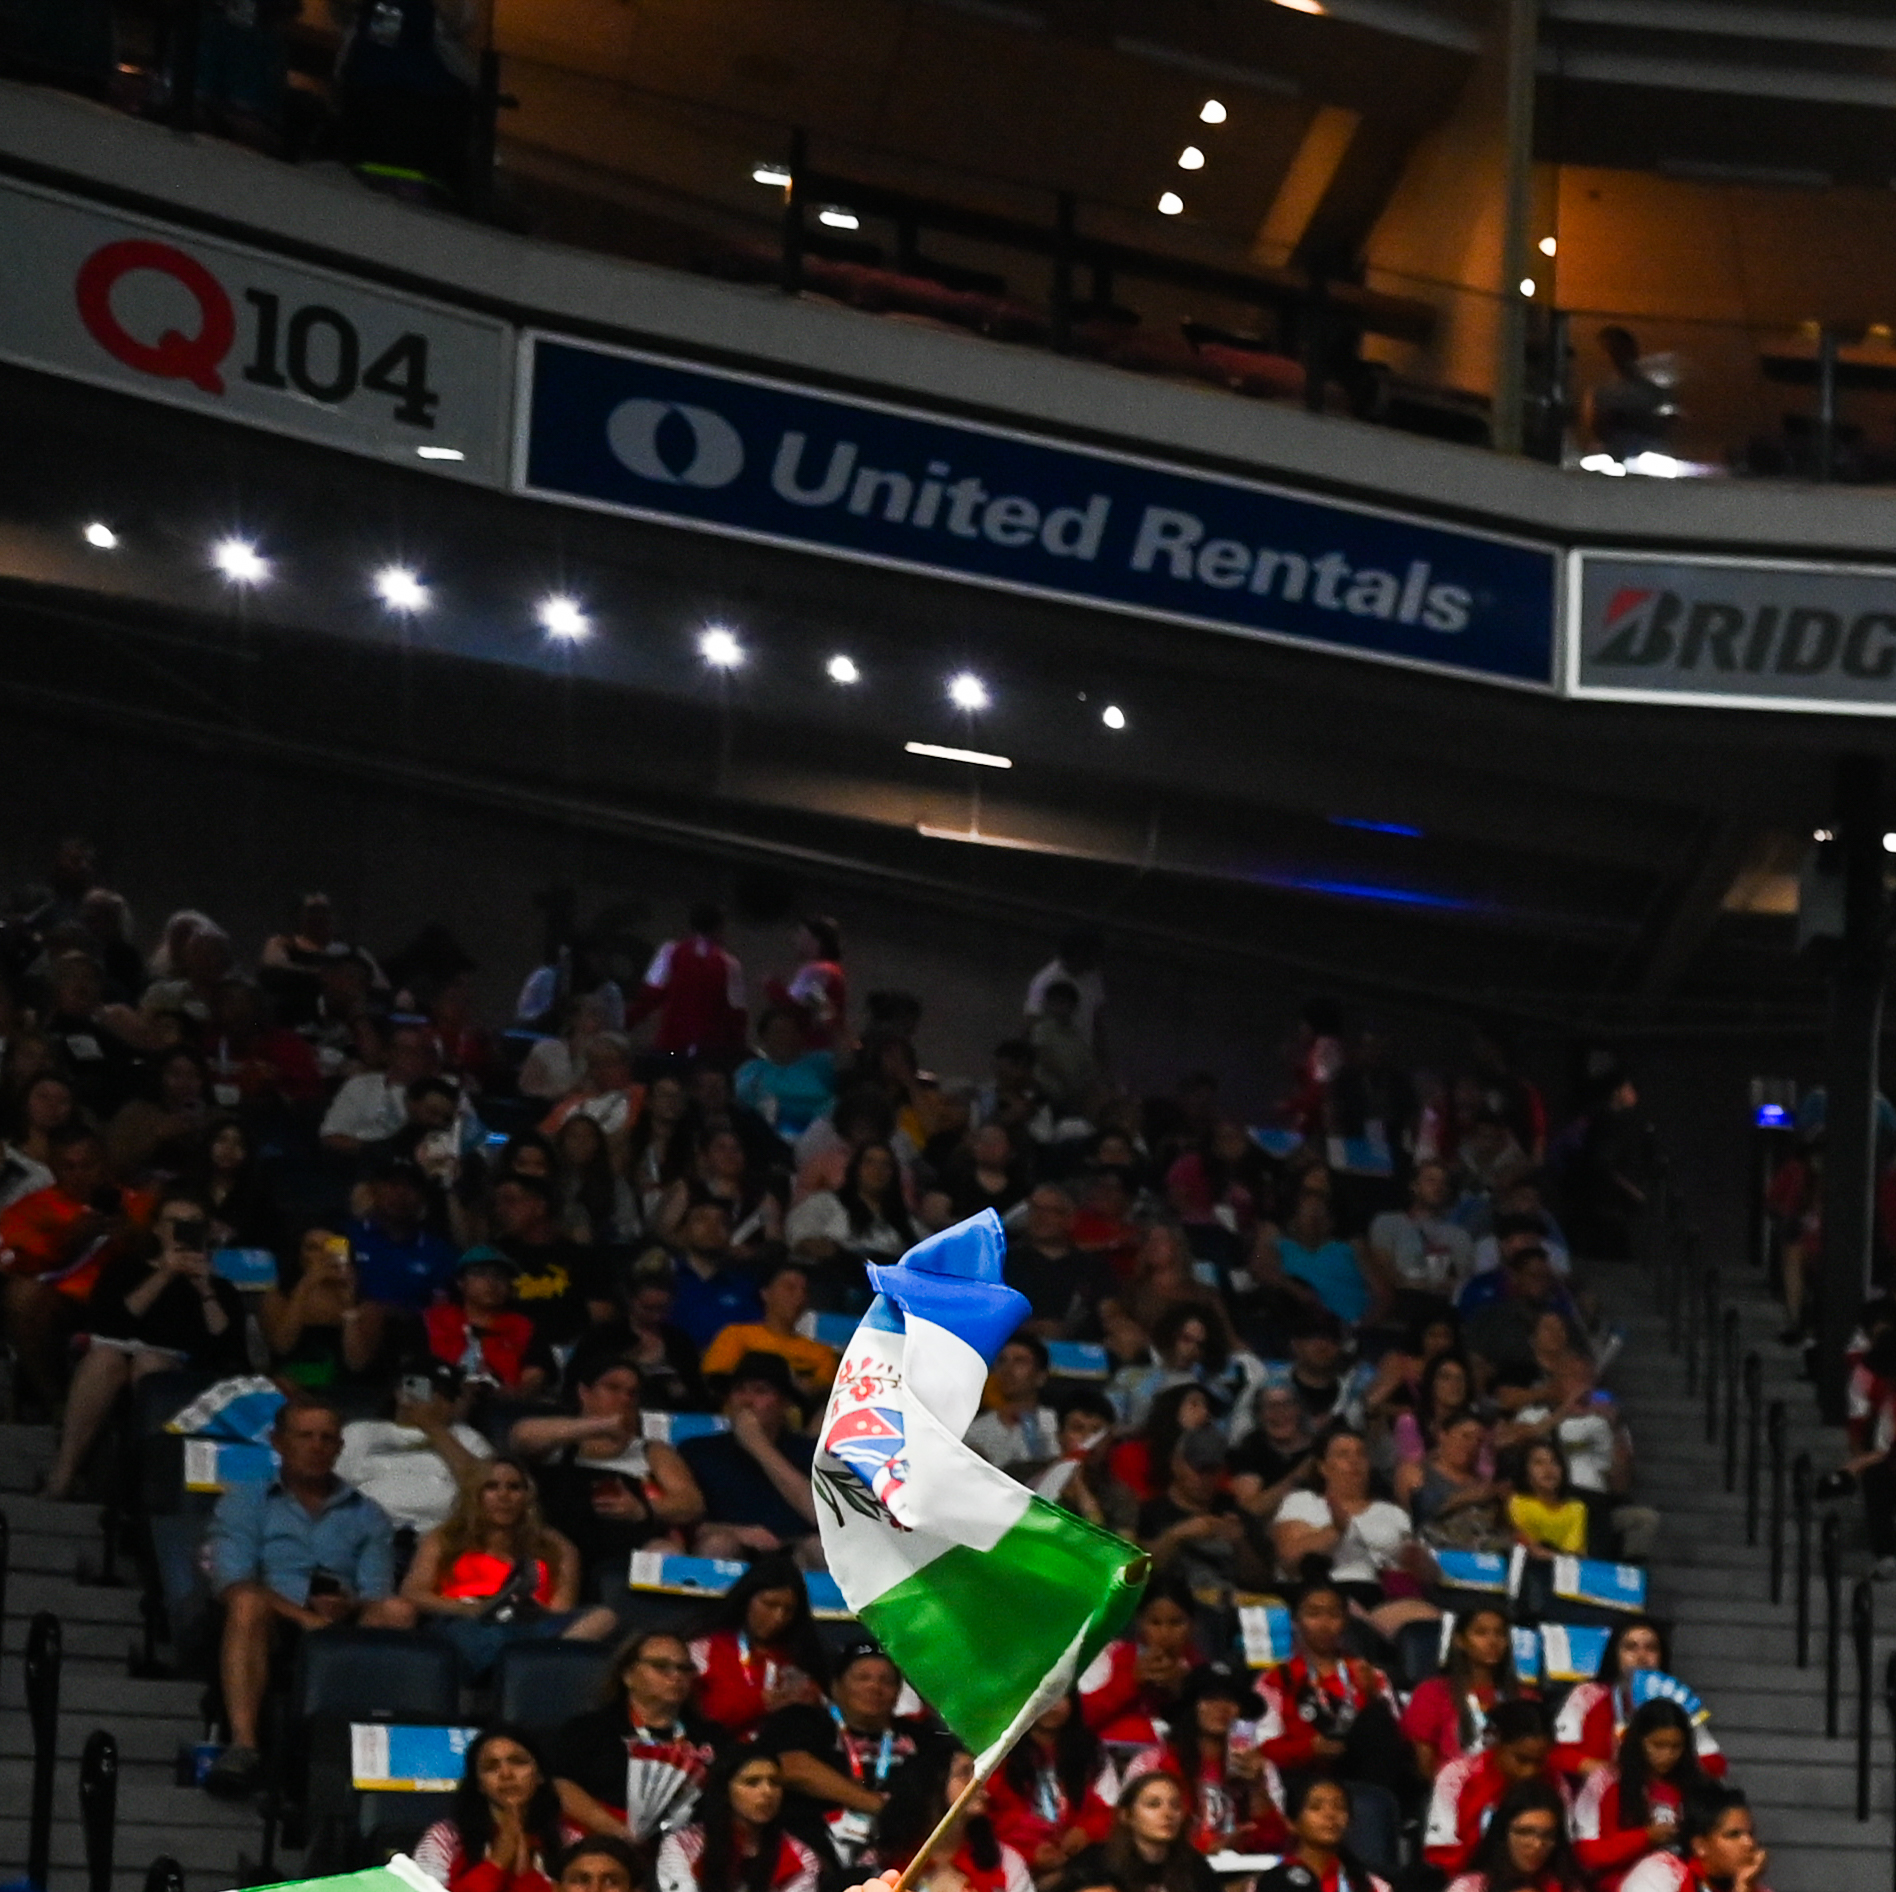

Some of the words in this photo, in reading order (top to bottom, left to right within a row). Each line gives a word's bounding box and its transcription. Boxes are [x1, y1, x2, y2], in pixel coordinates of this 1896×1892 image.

[76, 239, 440, 428] Q104
[770, 431, 1111, 561] United
[1130, 506, 1475, 634] Rentals
